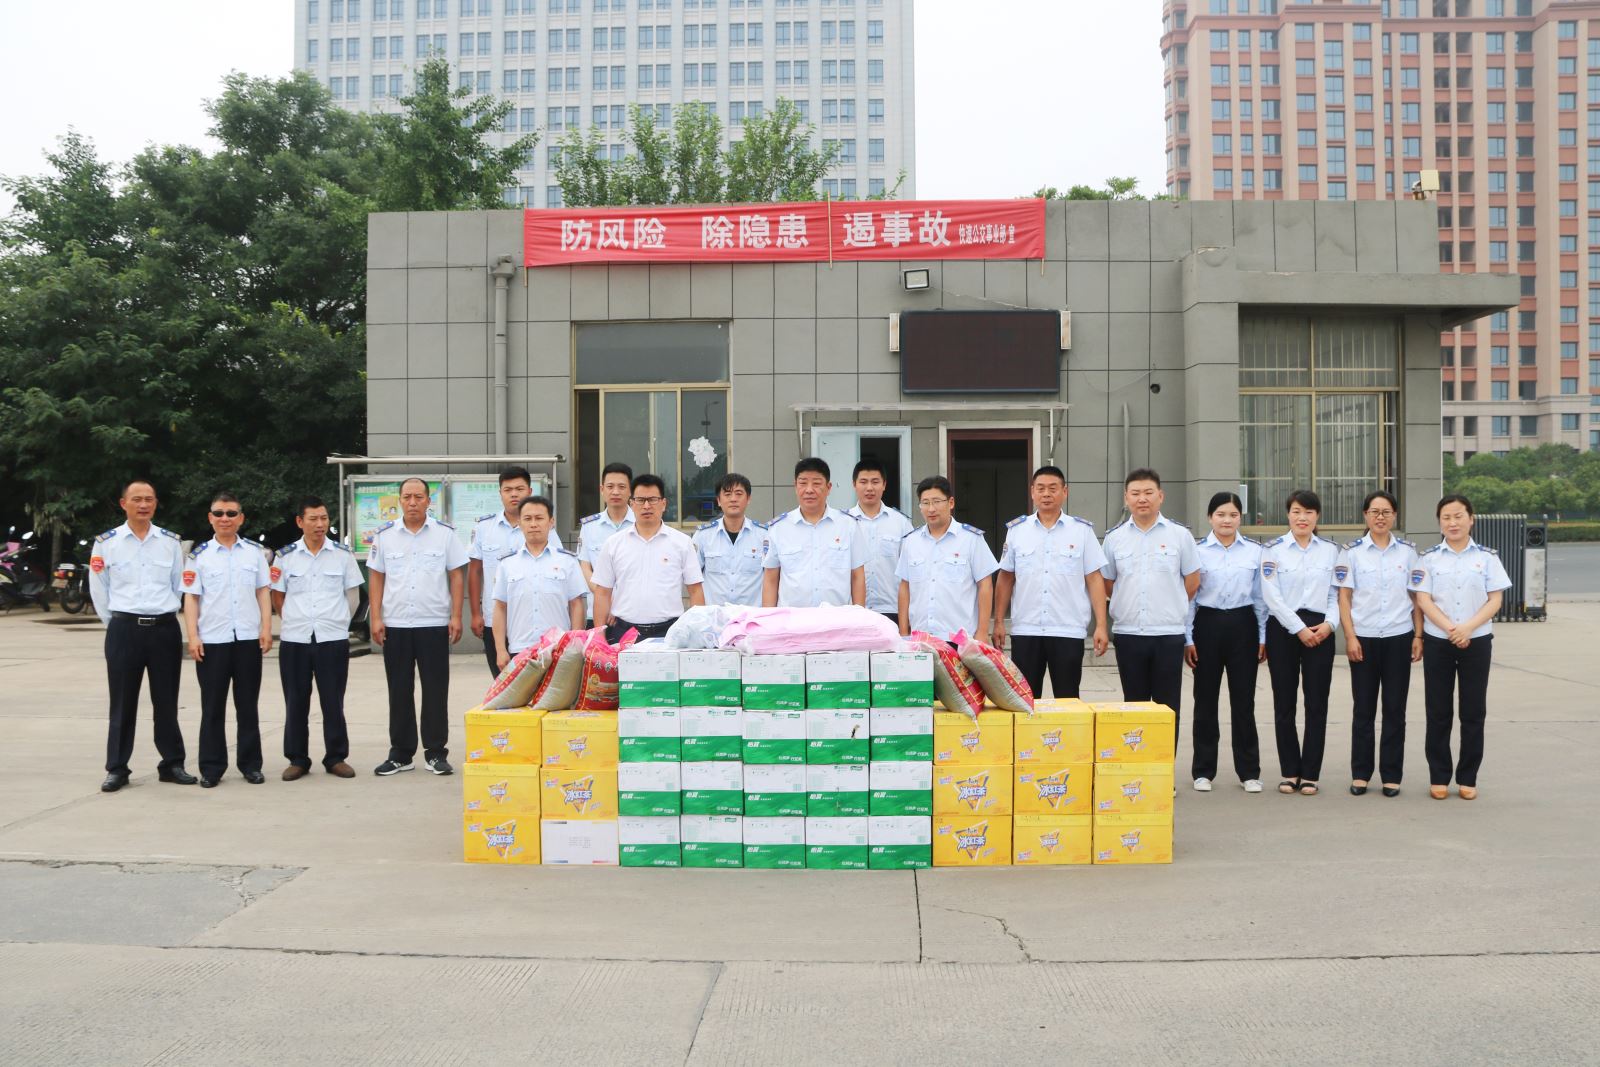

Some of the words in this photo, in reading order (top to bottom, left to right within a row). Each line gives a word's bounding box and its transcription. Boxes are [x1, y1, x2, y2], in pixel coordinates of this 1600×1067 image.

[561, 218, 667, 251] 防风险
[701, 214, 809, 249] 除隐患
[842, 210, 952, 247] 遏事故
